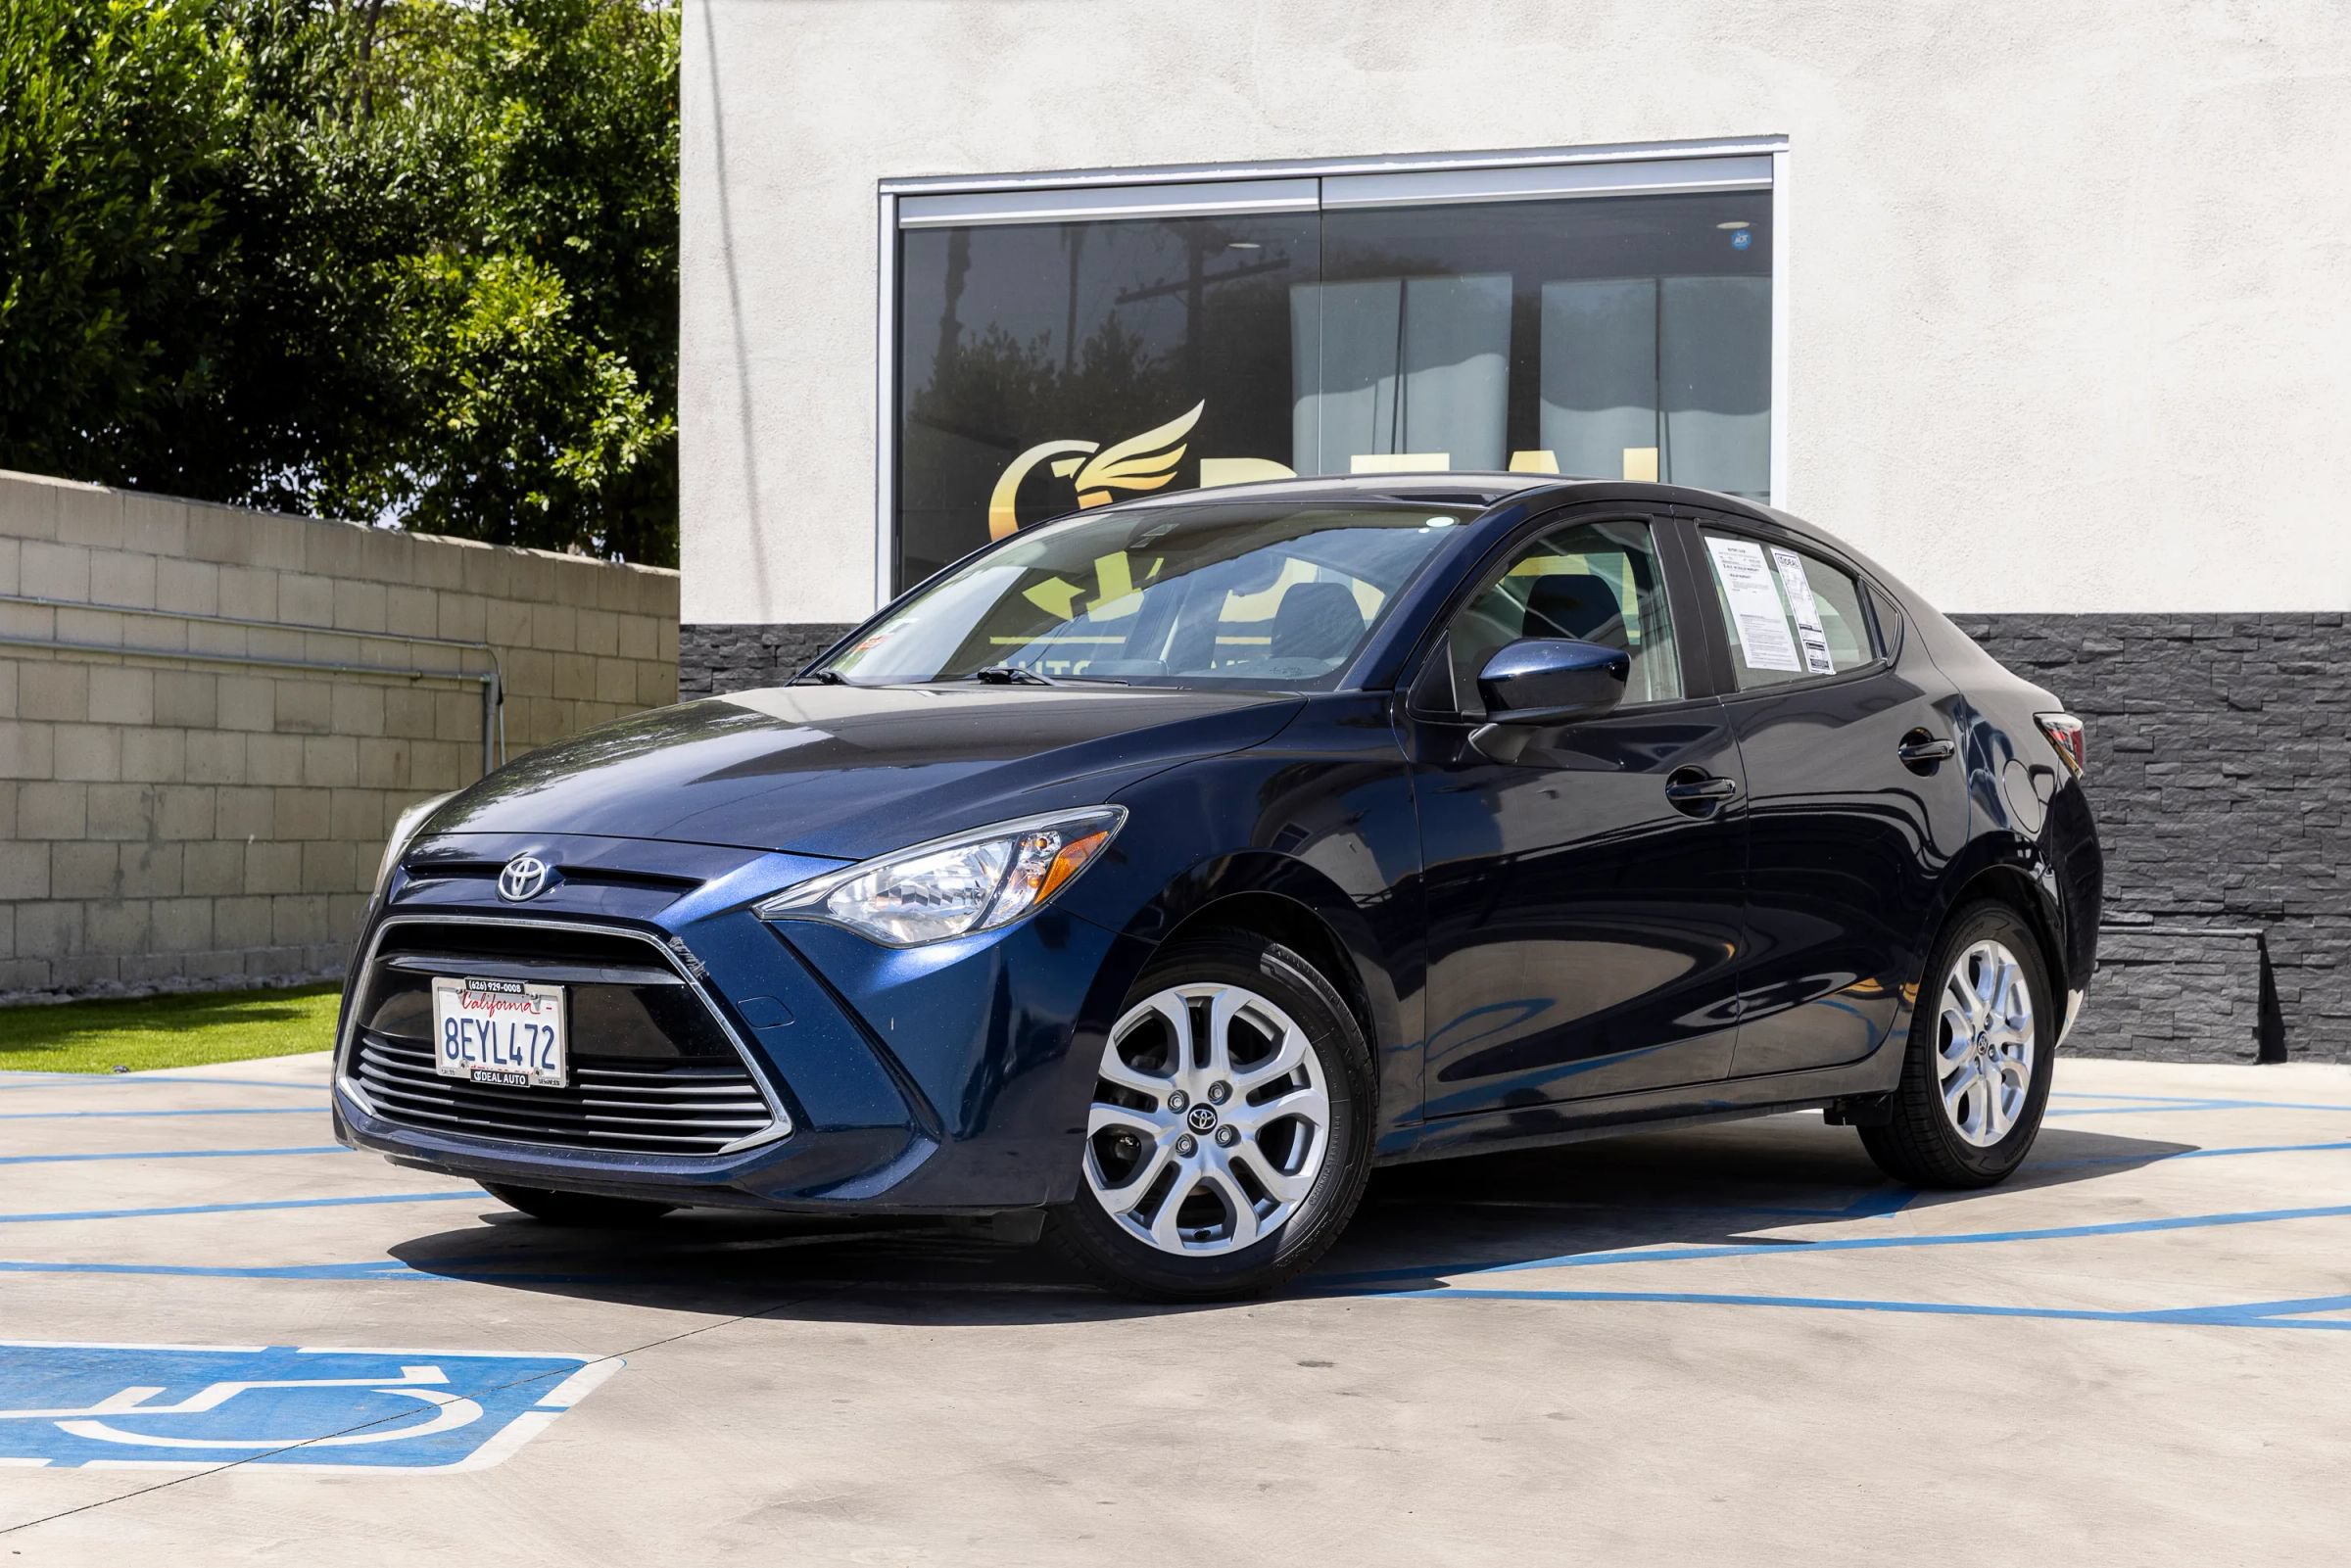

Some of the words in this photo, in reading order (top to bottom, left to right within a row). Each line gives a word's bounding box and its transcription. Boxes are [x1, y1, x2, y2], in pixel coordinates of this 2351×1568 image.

[468, 980, 487, 989] (626)
[487, 981, 521, 993] 929-0008
[461, 991, 541, 1018] California
[445, 1018, 555, 1069] 8EYL472
[503, 1073, 526, 1085] AUTO
